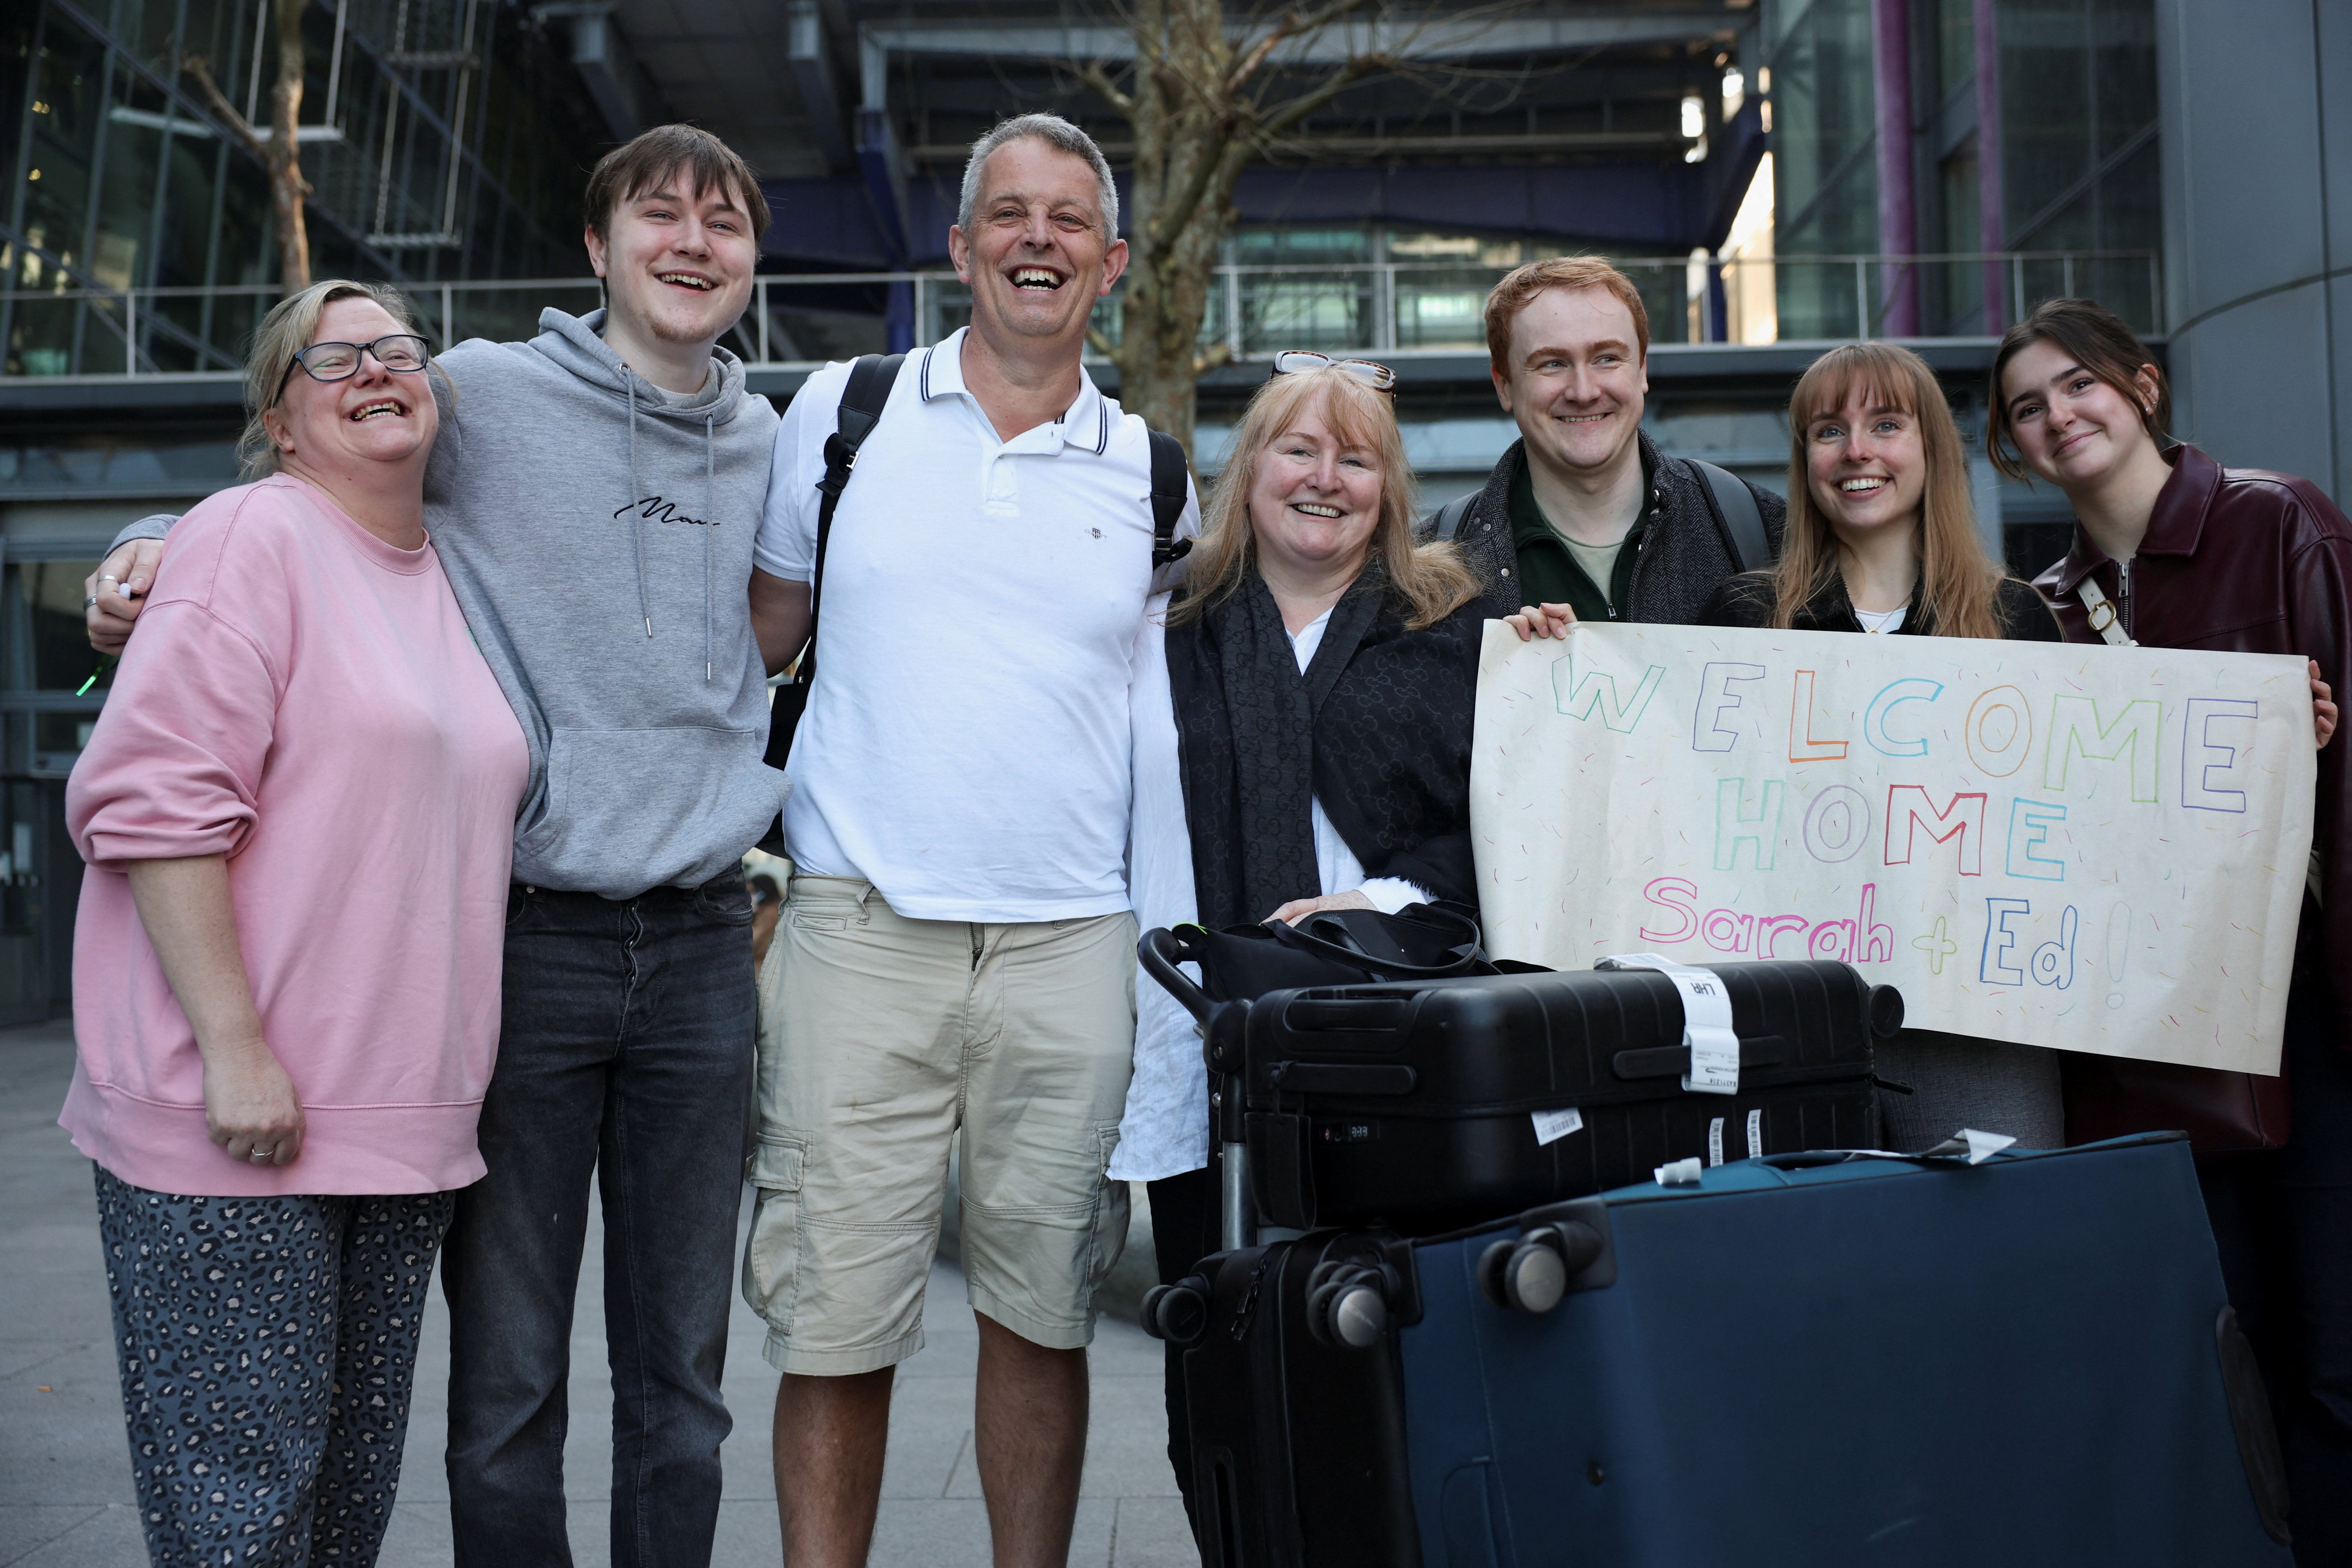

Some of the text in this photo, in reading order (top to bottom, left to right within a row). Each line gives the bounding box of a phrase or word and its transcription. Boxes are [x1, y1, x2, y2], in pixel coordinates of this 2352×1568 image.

[1551, 654, 2258, 812] WELCOME
[1713, 777, 2066, 882] HOME
[1639, 877, 1894, 964] Sarah
[1691, 982, 1716, 995] LHR
